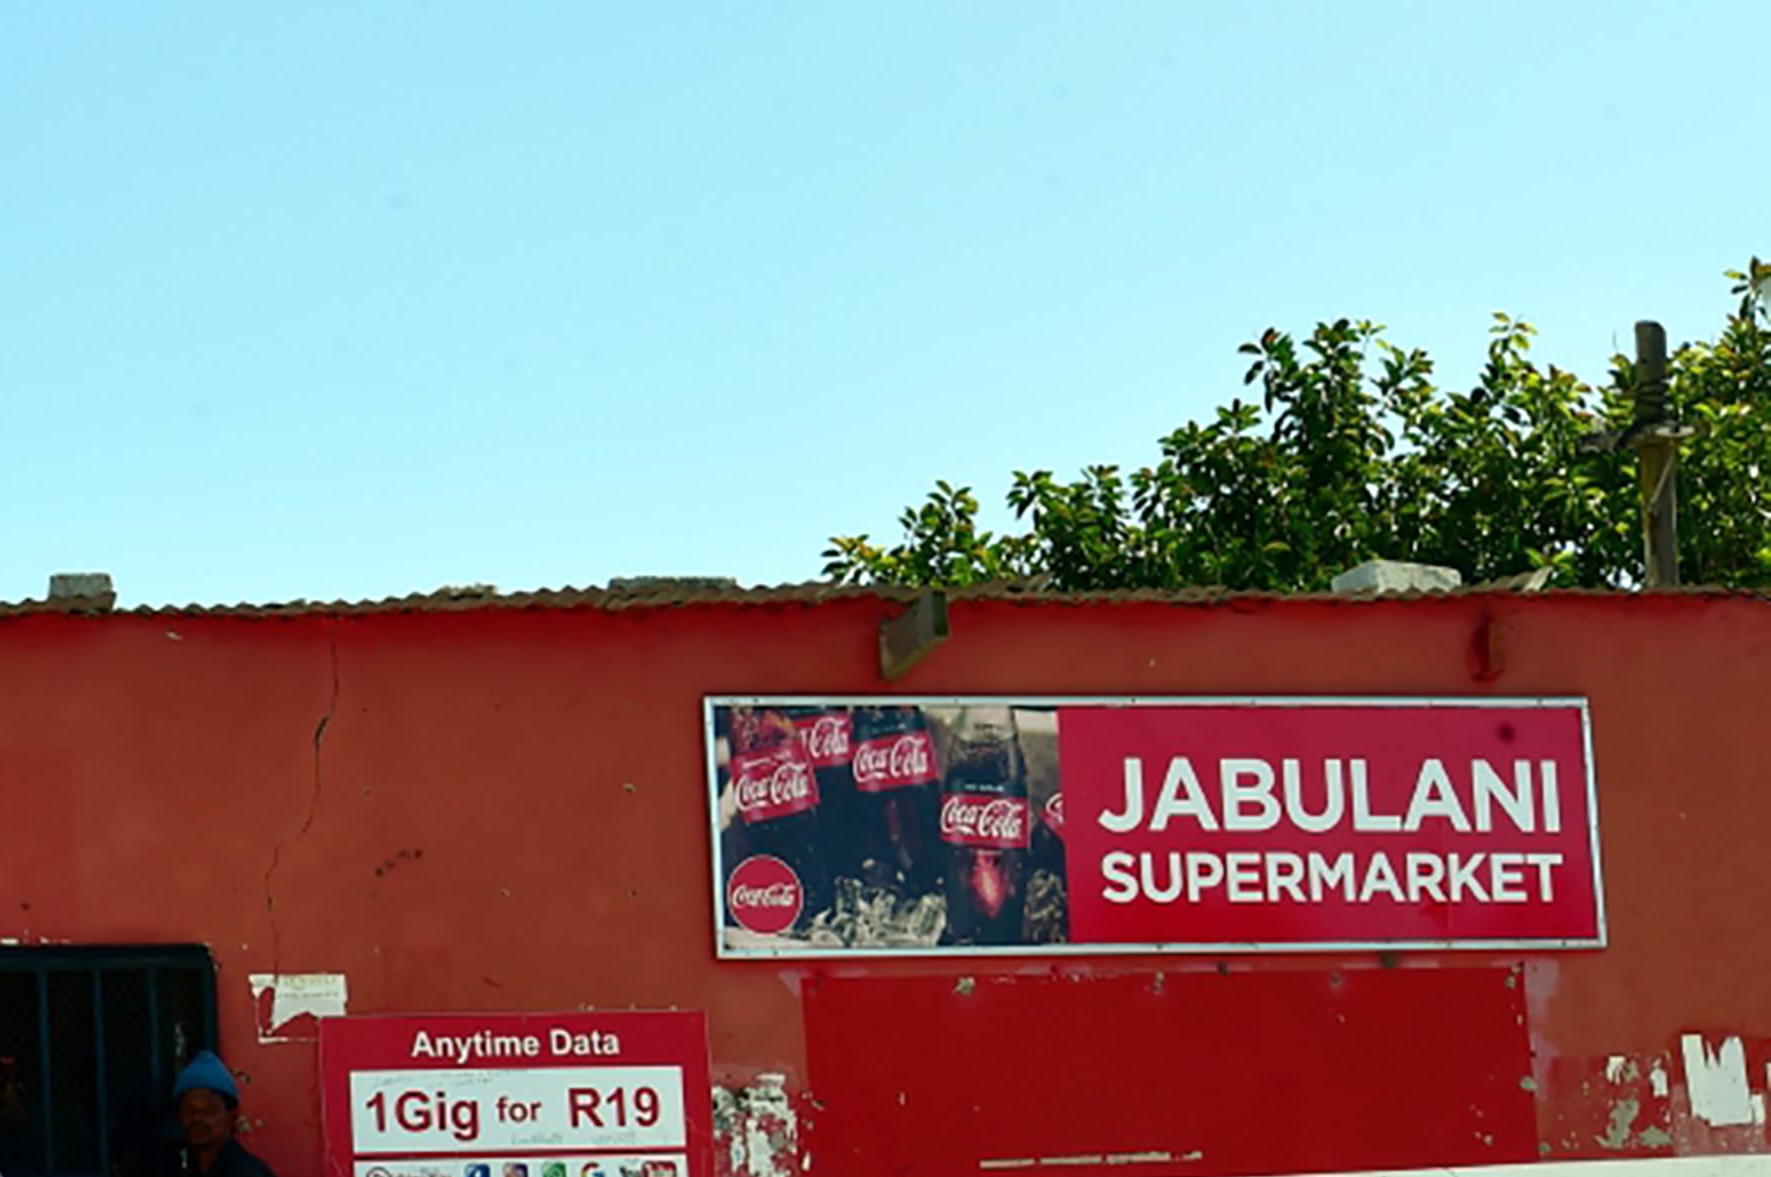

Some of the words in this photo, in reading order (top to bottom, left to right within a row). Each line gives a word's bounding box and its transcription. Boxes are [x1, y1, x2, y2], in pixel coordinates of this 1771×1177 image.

[1098, 757, 1562, 833] JABULANI
[1101, 851, 1563, 902] SUPERMARKET
[411, 1029, 540, 1064] Anytime
[550, 1028, 620, 1055] Data
[366, 1091, 479, 1141] 1Gig
[496, 1096, 542, 1123] for
[568, 1086, 660, 1128] R19
